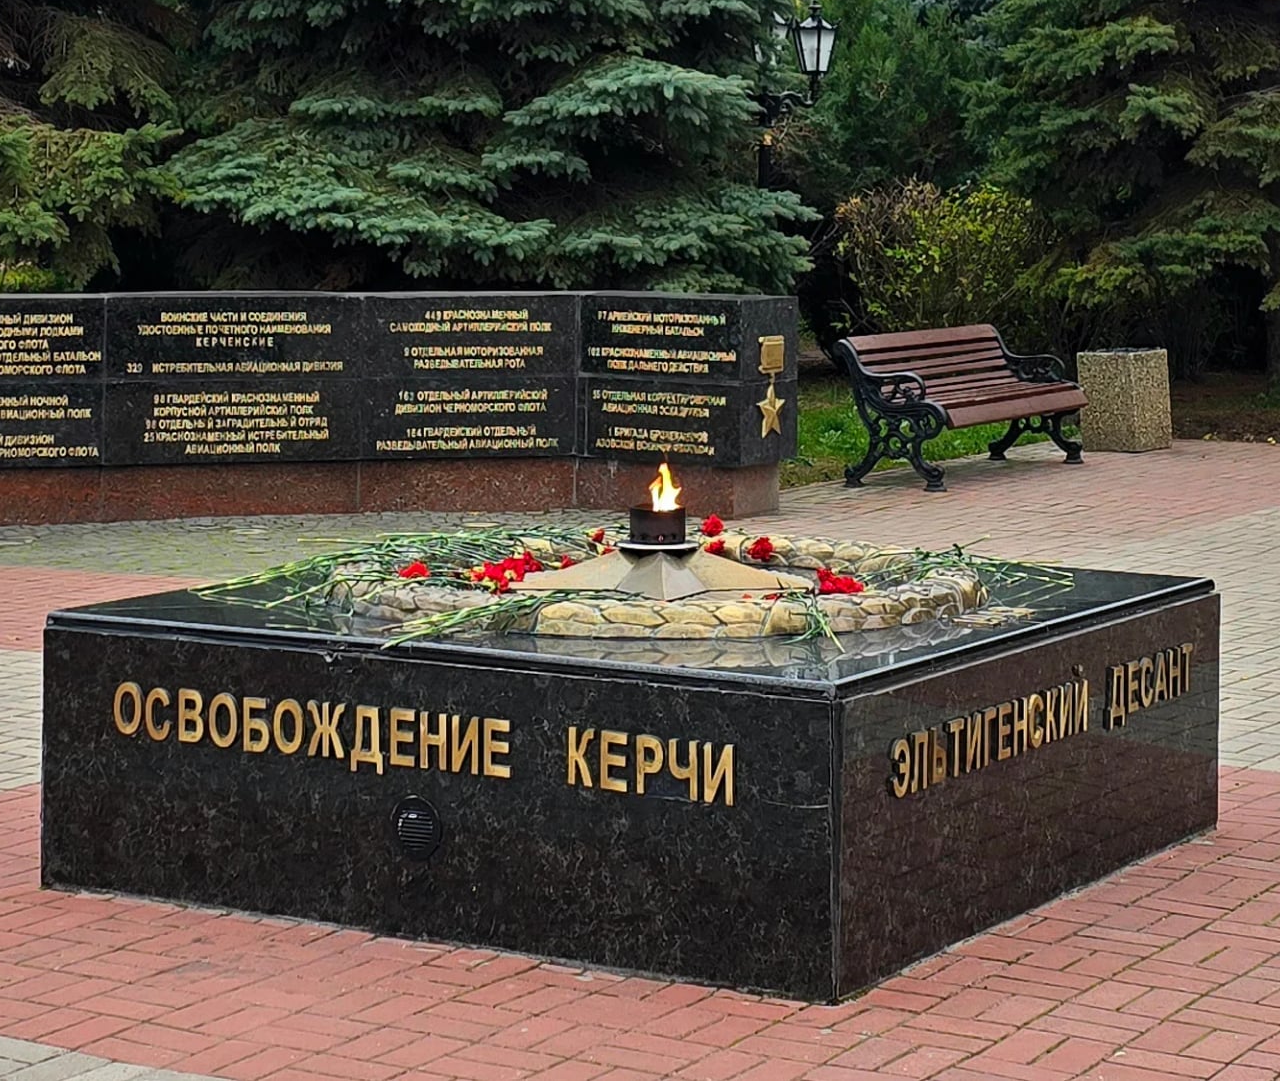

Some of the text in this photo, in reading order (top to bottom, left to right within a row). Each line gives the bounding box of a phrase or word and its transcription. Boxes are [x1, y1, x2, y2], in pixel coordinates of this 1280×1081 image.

[23, 314, 73, 325] ДИВИЗИОН
[161, 312, 208, 322] ВОИНСКИЕ
[210, 312, 238, 322] ЧАСТИ
[240, 312, 246, 321] И
[443, 308, 528, 320] КРАСНОЗНАМЕННЫЙ
[39, 326, 83, 337] ЛОДКАМИ
[138, 324, 331, 336] УДОСТОЕННЫЕ ПОЧЕТНОГО НАИМЕНОВАНИЯ
[389, 321, 450, 333] САМОХОДНЫЙ
[18, 339, 48, 350] ФЛОТА
[53, 351, 101, 361] БАТАЛЬОН
[411, 346, 464, 358] ОТДЕЛЬНАЯ
[152, 362, 233, 373] ИСТРЕБИТЕЛЬНАЯ
[235, 361, 301, 373] АВИАЦИОННАЯ
[302, 361, 343, 373] ДИВИЗИЯ
[505, 358, 526, 368] РОТА
[55, 365, 86, 375] ФЛОТА
[30, 395, 68, 406] НОЧНОЙ
[167, 391, 229, 404] ГВАРДЕЙСКИЙ
[231, 391, 320, 404] КРАСНОЗНАМЕННЫЙ
[417, 388, 470, 401] ОТДЕЛЬНЫЙ
[471, 388, 548, 400] АРТИЛЛЕРИЙСКИЙ
[602, 390, 646, 402] ОТДЕЛЬНАЯ
[66, 408, 92, 419] ПОЛК
[153, 404, 314, 417] КОРПУСНОЙ АРТИЛЛЕРИЙСКИЙ ПОЛК
[395, 402, 547, 415] ДИВИЗИОН ЧЕРНОМОРСКОГО ФЛОТА
[158, 417, 214, 430] ОТДЕЛЬНЫЙ
[298, 416, 328, 428] ОТРЯД
[156, 430, 246, 442] КРАСНОЗНАМЕННЫЙ
[247, 429, 329, 441] ИСТРЕБИТЕЛЬНЫЙ
[423, 425, 482, 437] ГВАРДЕЙСКИЙ
[484, 424, 537, 436] ОТДЕЛЬНЫЙ
[4, 435, 54, 447] ДИВИЗИОН
[469, 437, 534, 449] АВИАЦИОННЫЙ
[68, 447, 99, 458] ФЛОТА
[185, 443, 281, 455] АВИАЦИОННЫЙ ПОЛК
[888, 643, 1193, 798] ЭЛЬТИГЕНСКИЙ ДЕСАНТ
[113, 681, 735, 807] ОСВОБОЖДЕНИЕ КЕРЧИ
